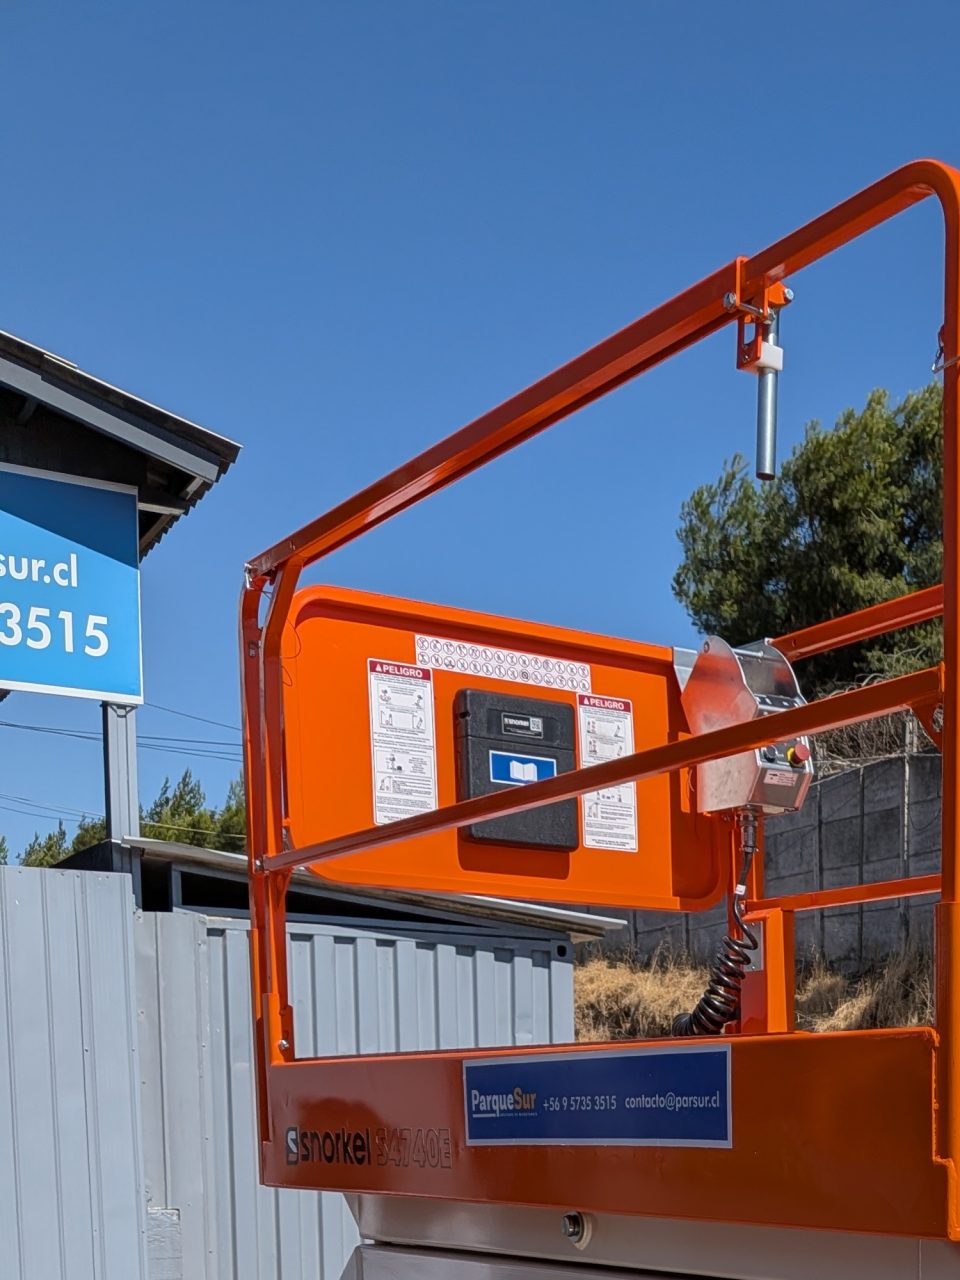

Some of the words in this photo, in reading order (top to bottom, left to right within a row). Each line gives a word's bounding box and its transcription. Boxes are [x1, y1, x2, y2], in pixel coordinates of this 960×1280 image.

[0, 602, 109, 657] 3515
[383, 664, 423, 678] PELIGRO
[590, 698, 625, 710] PELIGRO
[471, 1087, 537, 1117] ParqueSur
[543, 1097, 560, 1111] +56
[562, 1097, 568, 1111] 9
[570, 1096, 592, 1111] 5735
[594, 1095, 617, 1110] 3515
[625, 1090, 720, 1112] contacto@parsur.cl
[301, 1128, 371, 1166] snorkel
